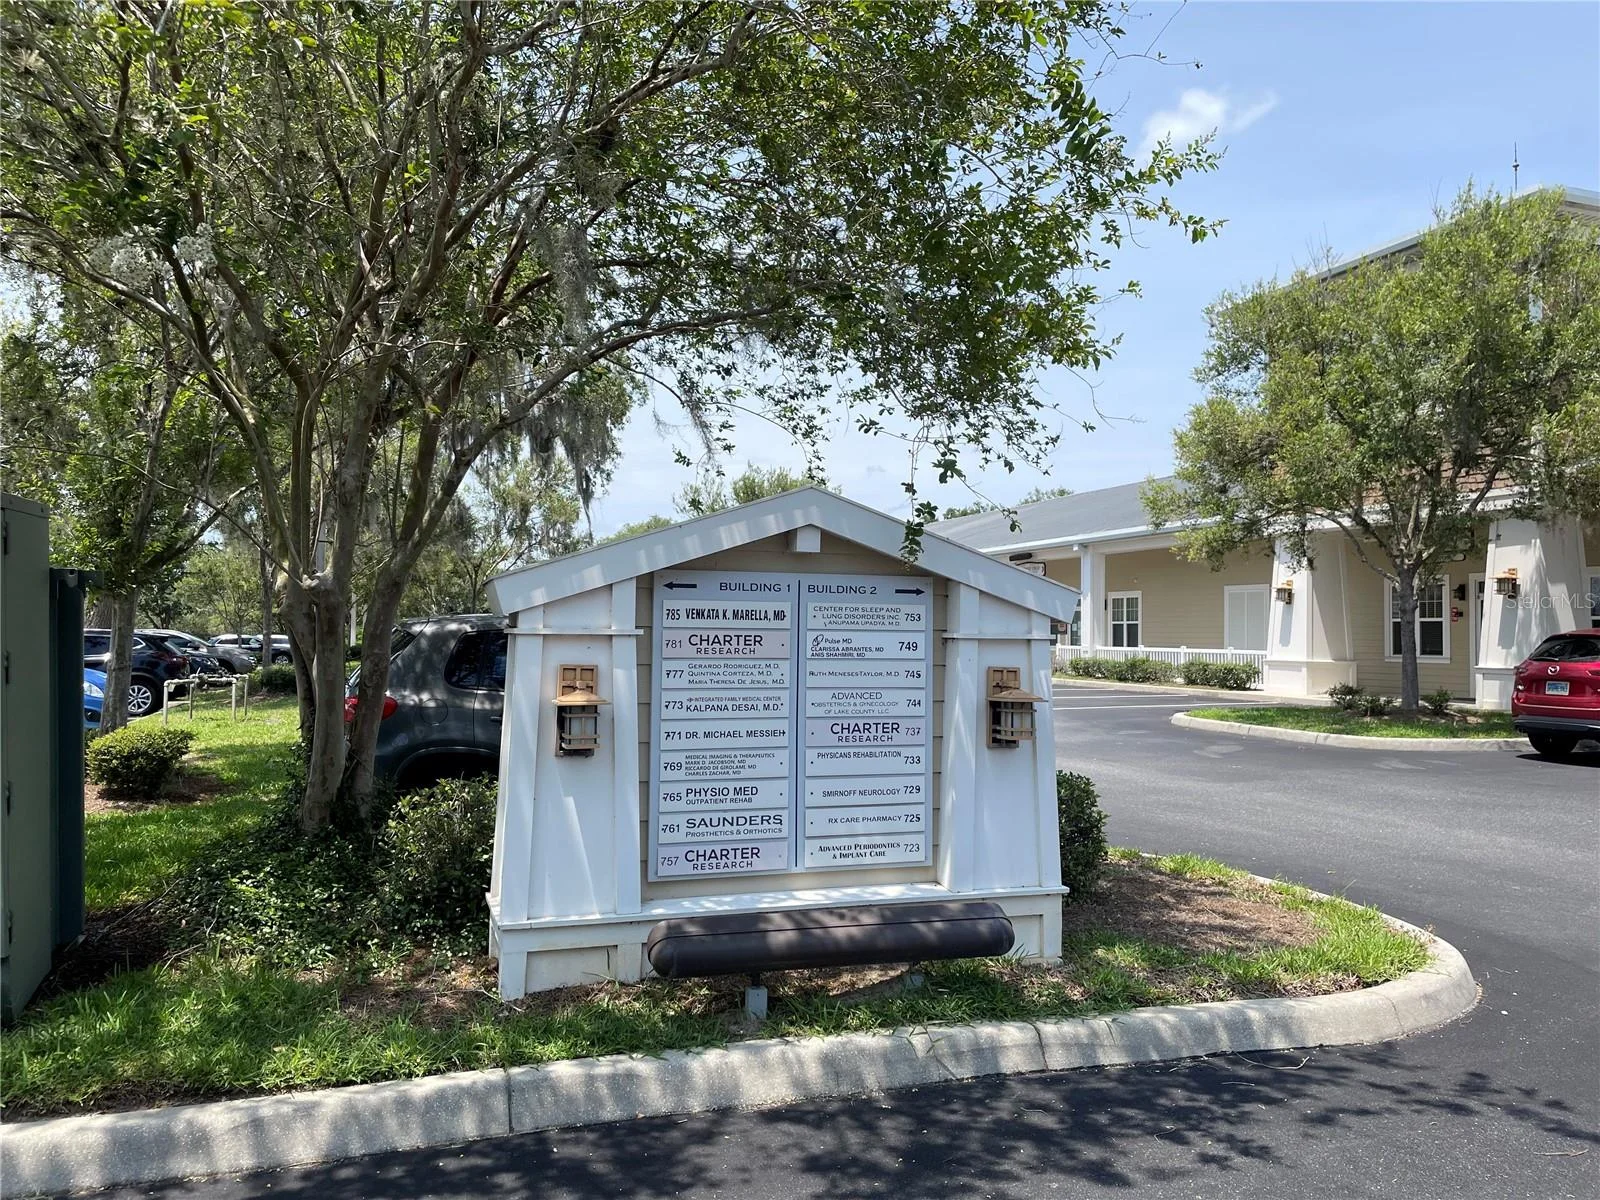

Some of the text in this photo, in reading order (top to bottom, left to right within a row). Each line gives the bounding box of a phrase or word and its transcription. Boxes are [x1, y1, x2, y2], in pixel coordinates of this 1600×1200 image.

[720, 582, 791, 592] BUILDING 1
[808, 585, 867, 594] BUILDING
[666, 608, 785, 622] 785 VENKATA K. MARELLA, MD
[905, 613, 921, 621] 753
[665, 640, 682, 648] 781
[688, 634, 763, 646] CHARTER
[696, 647, 756, 655] RESEARCH
[898, 641, 918, 652] 749
[665, 670, 684, 679] 777
[905, 670, 921, 678] 745
[831, 692, 882, 700] ADVANCED
[665, 701, 683, 710] 773
[686, 704, 729, 712] KALPANA
[732, 704, 761, 712] DESAI,
[907, 699, 921, 707] 744
[830, 722, 900, 734] CHARTER
[905, 728, 921, 736] 737
[664, 732, 681, 740] 771
[704, 731, 743, 739] MICHAEL
[838, 735, 893, 743] RESEARCH
[904, 756, 920, 765] 733
[664, 762, 682, 771] 769
[686, 787, 758, 797] PHYSIO MED
[859, 788, 900, 796] NEUROLOGY
[904, 785, 920, 794] 729
[663, 792, 682, 802] 765
[686, 815, 783, 828] SAUNDERS
[904, 814, 920, 822] 725
[662, 824, 680, 833] 761
[686, 830, 734, 838] PROSTHETICS
[854, 842, 901, 850] PERIODONTICS
[904, 844, 919, 852] 723
[685, 847, 760, 863] CHARTER
[661, 857, 679, 866] 757
[693, 861, 753, 871] RESEARCH
